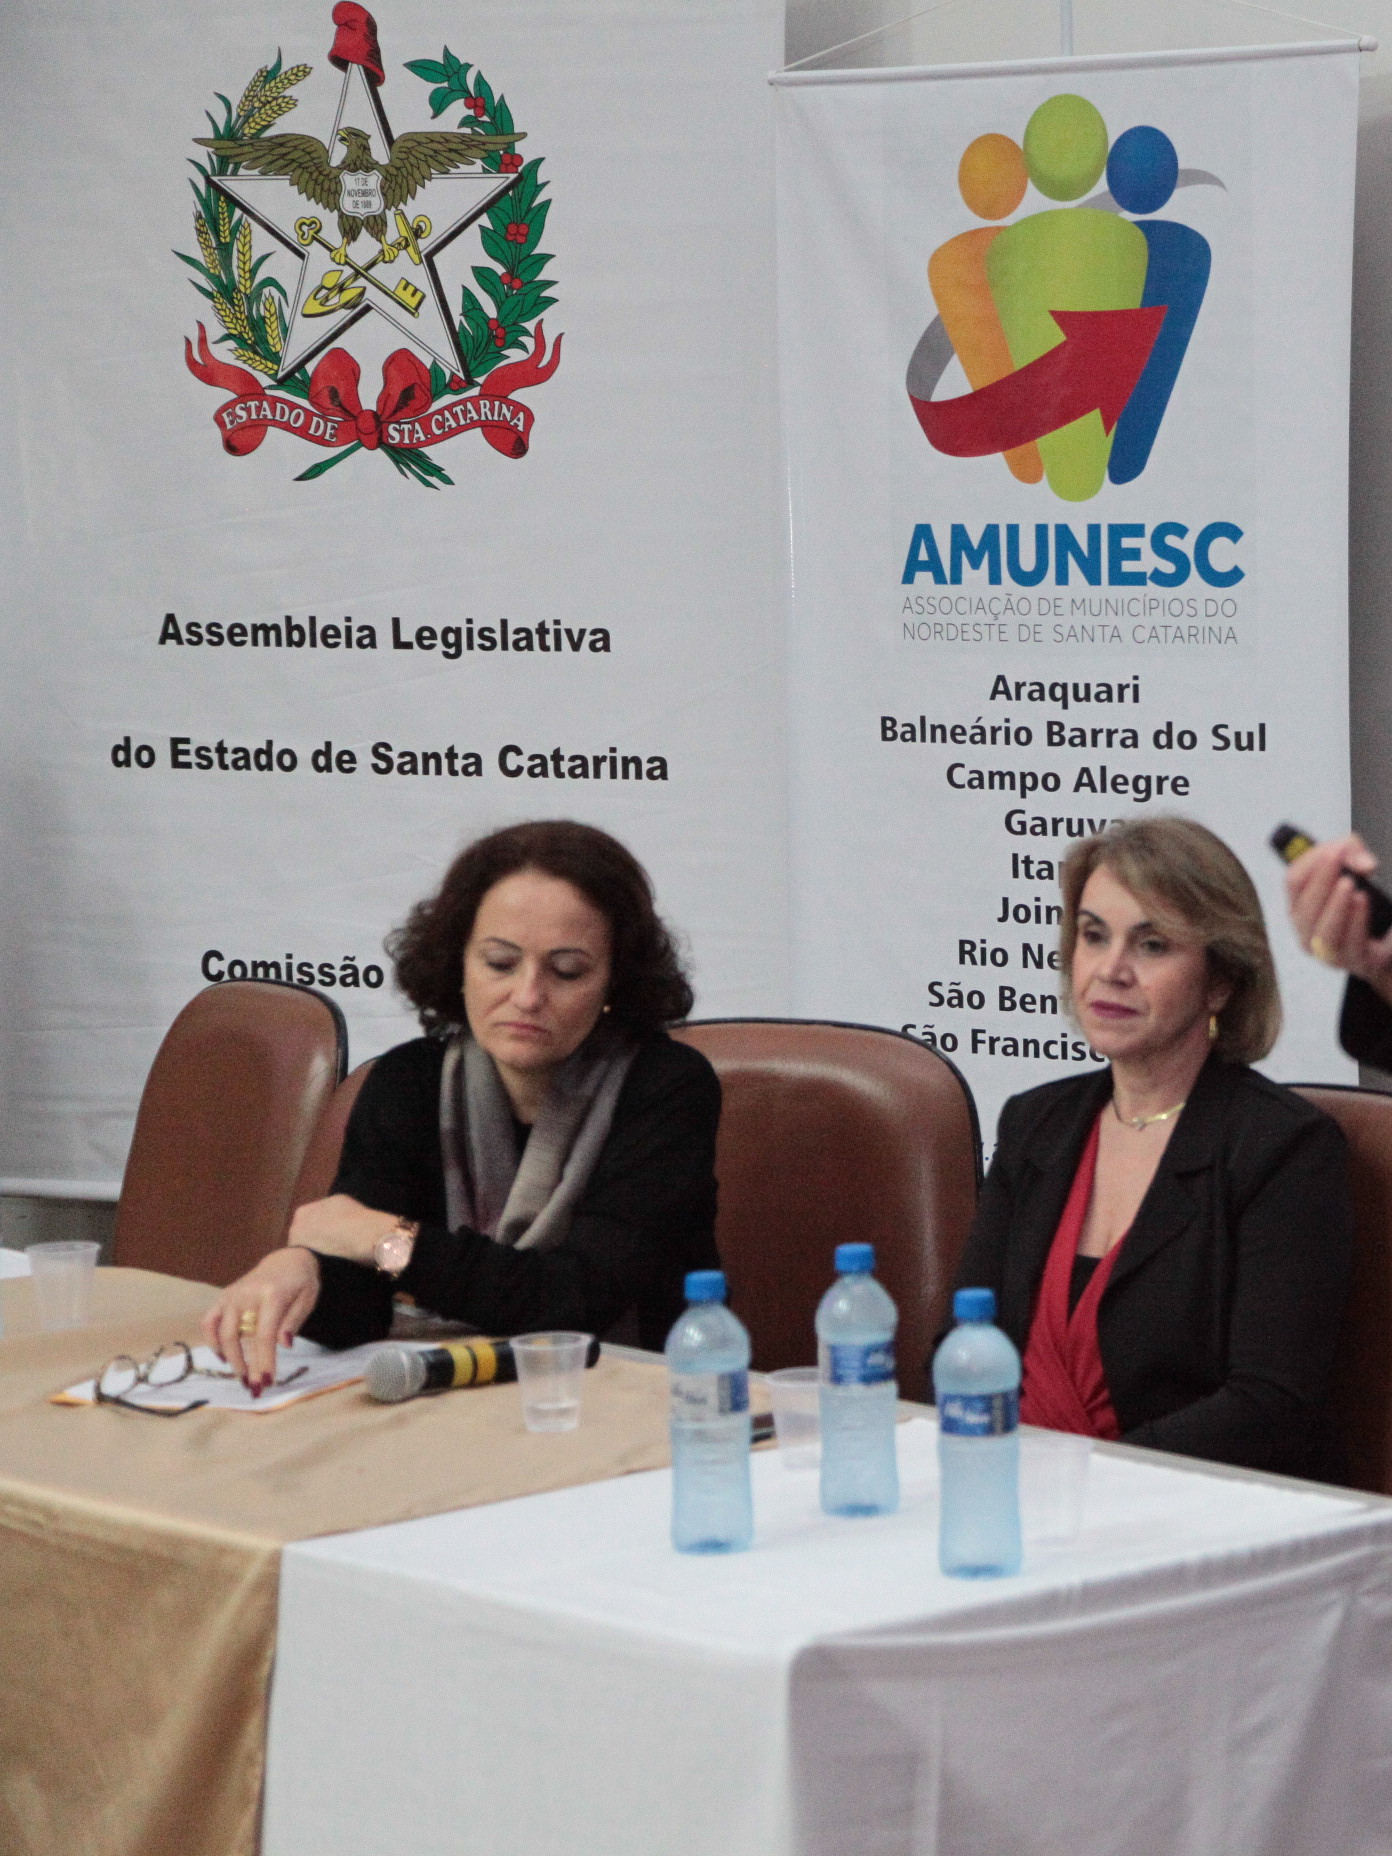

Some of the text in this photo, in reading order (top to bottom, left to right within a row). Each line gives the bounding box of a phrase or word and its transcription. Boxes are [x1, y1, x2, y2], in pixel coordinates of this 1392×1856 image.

[222, 399, 525, 444] ESTADO DE STA. CATARINA
[901, 521, 1245, 588] AMUNESC
[902, 592, 1237, 620] ASSOCIAÇÃO DE MUNICÍPIOS DO
[158, 613, 612, 659] Assembleia Legislativa
[902, 621, 1238, 645] NORDESTE DE SANTA CATARINA
[989, 674, 1140, 710] Araquari
[880, 715, 1267, 752] Balneário Barra do Sul
[110, 736, 670, 781] do Estado de Santa Catarina
[946, 762, 1190, 803] Campo Alegre
[201, 949, 385, 989] Comissão
[958, 938, 1009, 968] Rio
[927, 981, 986, 1010] São
